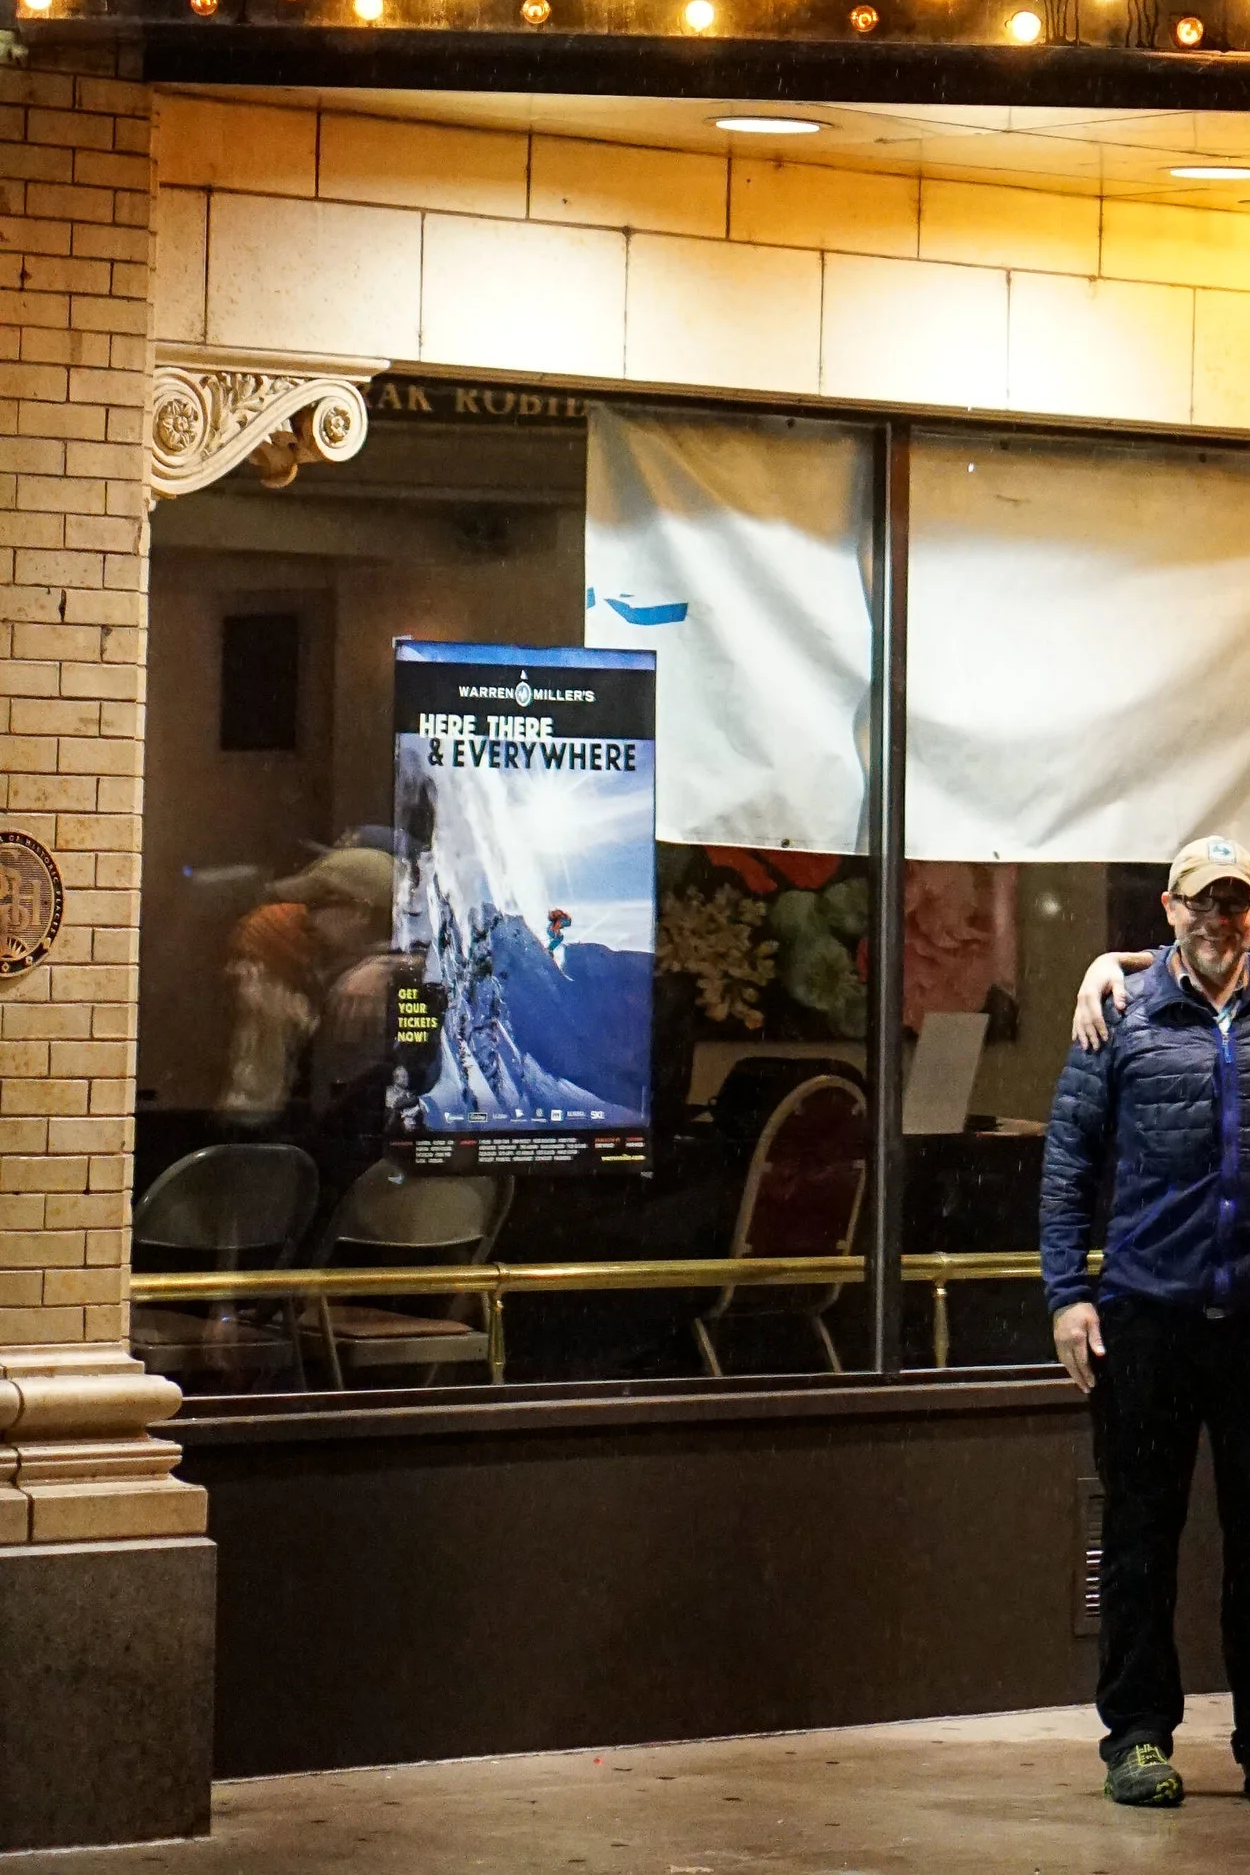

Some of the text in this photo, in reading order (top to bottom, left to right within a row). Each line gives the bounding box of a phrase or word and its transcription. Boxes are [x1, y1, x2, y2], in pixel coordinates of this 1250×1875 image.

[458, 685, 596, 703] WARREN MILLER'S
[419, 712, 554, 740] HERE THERE
[427, 737, 637, 772] & EVERYWHERE
[397, 988, 418, 1001] GET
[397, 1002, 428, 1014] YOUR
[397, 1016, 438, 1029] TICKETS
[396, 1030, 428, 1043] NOW!
